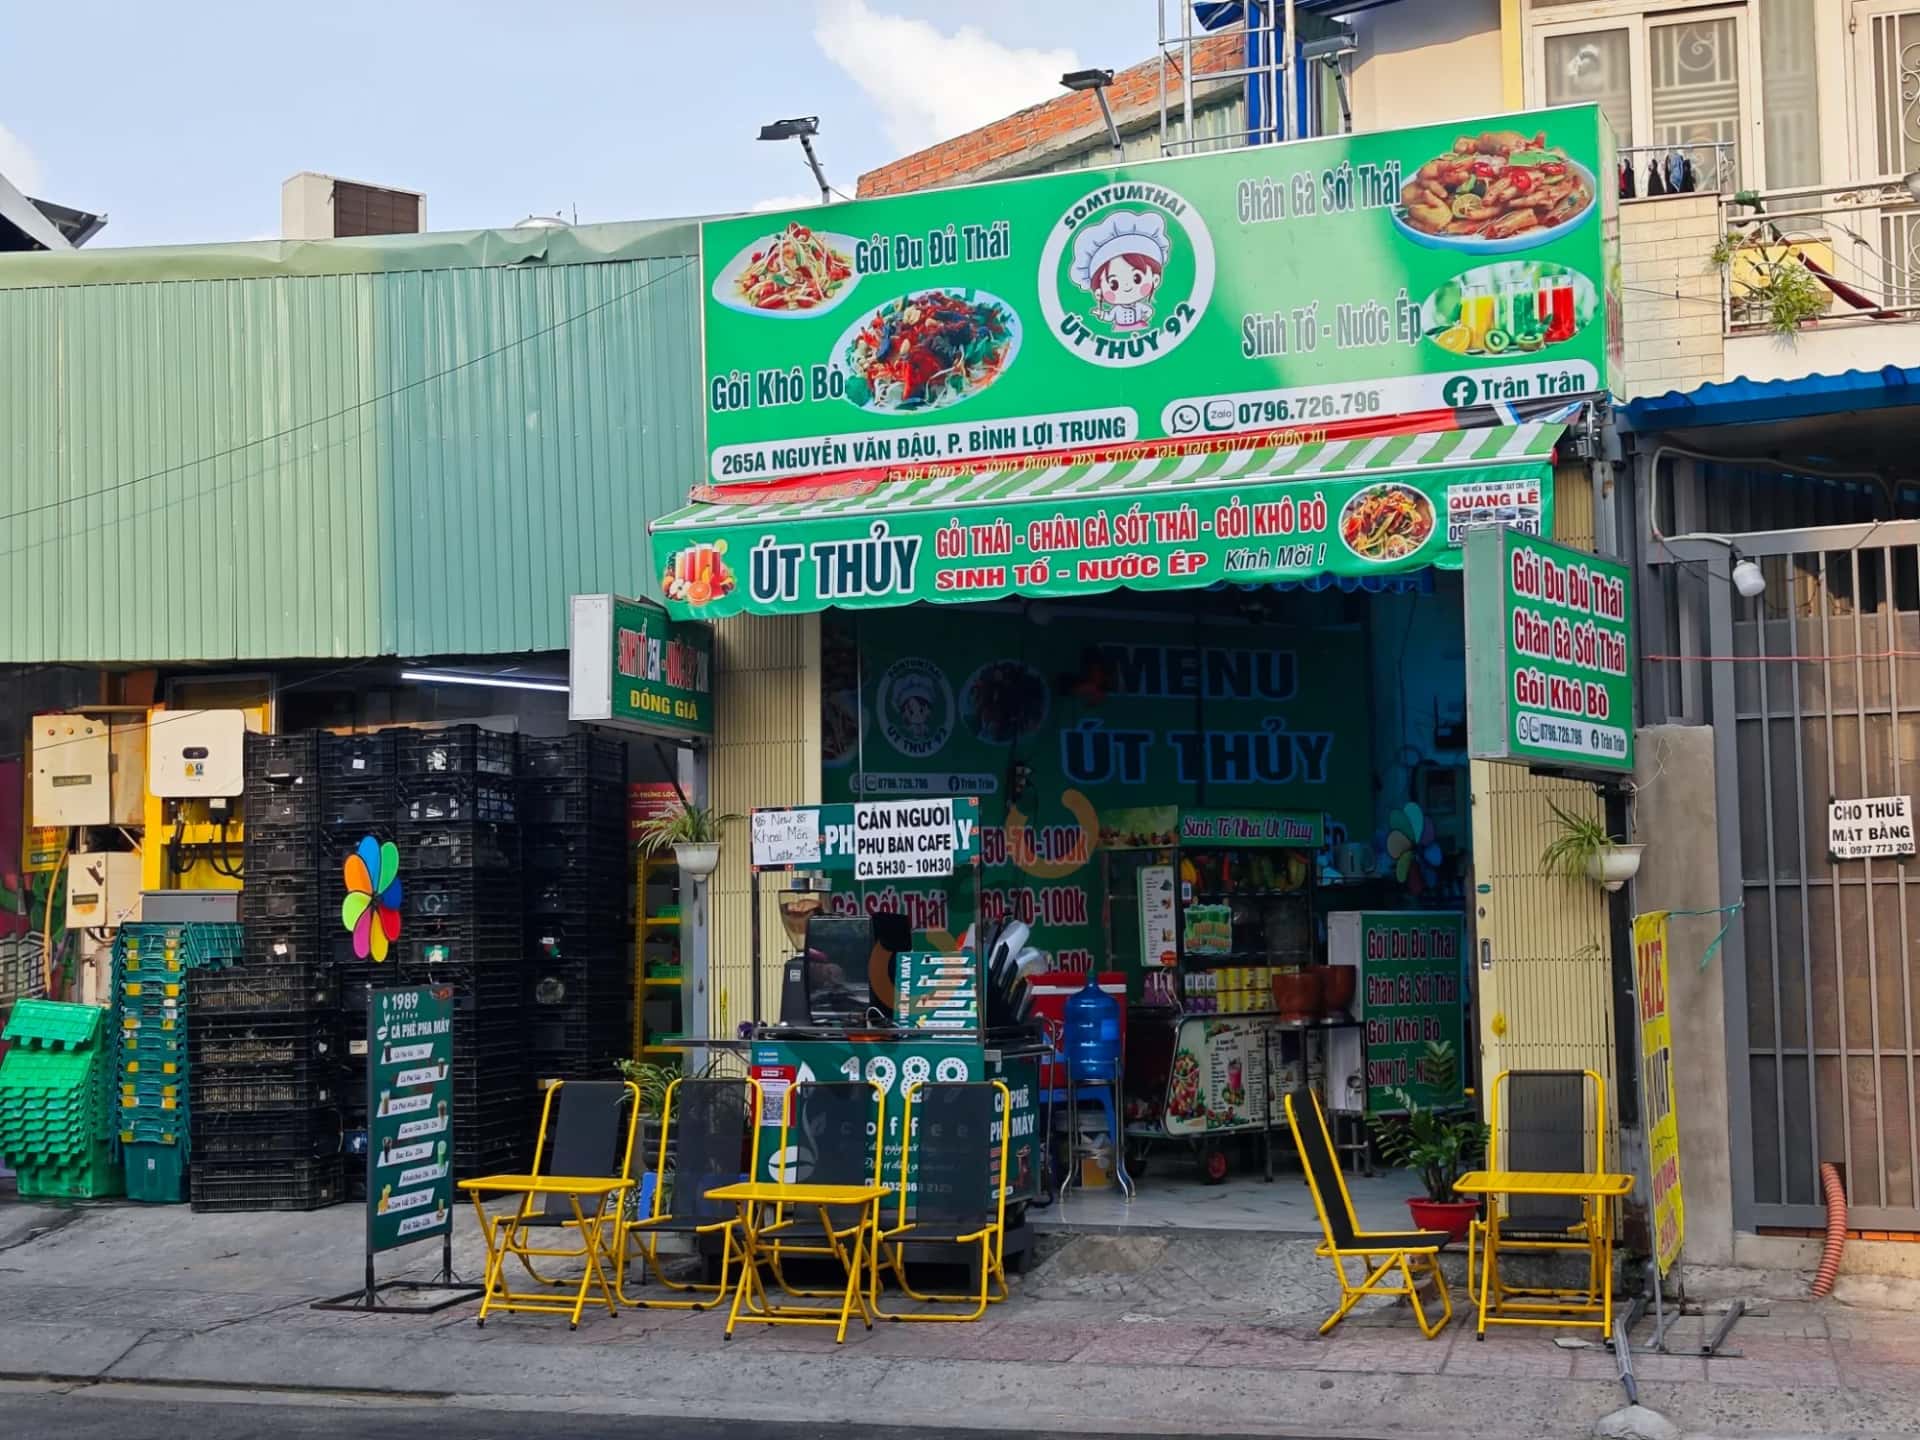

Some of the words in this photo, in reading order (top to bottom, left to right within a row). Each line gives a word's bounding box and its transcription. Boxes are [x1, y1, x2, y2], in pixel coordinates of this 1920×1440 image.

[1064, 185, 1187, 230] SOMTUMTHAI
[1237, 180, 1286, 224] Chân
[1290, 176, 1315, 217] Gà
[1322, 161, 1354, 214] Sốt
[1359, 160, 1400, 210] Thái
[855, 235, 891, 274] Gỏi
[896, 236, 923, 270] Đu
[930, 223, 957, 266] Đủ
[963, 221, 1010, 260] Thái
[1060, 314, 1091, 346] ÚT
[1095, 331, 1160, 360] THỦY
[1166, 303, 1196, 337] 92
[1242, 314, 1287, 358] Sinh
[1292, 301, 1319, 351] Tố
[1336, 299, 1390, 348] Nước
[1397, 288, 1422, 348] Ép
[712, 366, 750, 411] Gỏi
[758, 368, 805, 408] Khô
[812, 362, 843, 402] Bò
[1239, 391, 1380, 424] 0796.726.796
[1482, 373, 1530, 401] Trân
[1536, 369, 1586, 396] Trân
[722, 450, 766, 476] 265A
[772, 437, 847, 471] NGUYỄN
[853, 435, 891, 462] VĂN
[897, 429, 941, 460] ĐẬU,
[948, 428, 963, 454] P.
[970, 420, 1016, 451] BÌNH
[1023, 421, 1052, 448] LỢI
[1060, 416, 1127, 446] TRUNG
[1450, 492, 1512, 510] QUANG
[1517, 488, 1539, 505] LÊ
[753, 541, 801, 600] ÚT
[815, 522, 920, 596] THỦY
[937, 519, 966, 559] GỎI
[971, 519, 1011, 554] THÁI
[1029, 518, 1081, 551] CHÂN
[1084, 510, 1109, 547] GÀ
[1115, 506, 1150, 546] SỐT
[1154, 504, 1197, 542] THÁI
[1217, 496, 1249, 539] GỎI
[1254, 495, 1293, 535] KHÔ
[1300, 492, 1327, 532] BÒ
[936, 568, 1004, 592] SINH
[1014, 557, 1050, 586] TỐ
[1080, 549, 1162, 581] NƯỚC
[1169, 545, 1208, 577] ÉP
[1225, 548, 1269, 572] Kính
[1277, 544, 1315, 569] Mời
[1513, 549, 1539, 595] Gỏi
[1544, 559, 1564, 602] Đu
[1569, 565, 1589, 610] Đủ
[1592, 574, 1624, 619] Thái
[1514, 610, 1551, 656] Chân
[1554, 619, 1571, 661] Gà
[1575, 620, 1596, 667] Sốt
[1599, 630, 1626, 674] Thái
[1090, 643, 1297, 700] MENU
[1516, 669, 1546, 706] Gỏi
[1551, 677, 1582, 713] Khô
[1587, 683, 1609, 718] Bò
[1060, 717, 1156, 785] ÚT
[1166, 715, 1335, 785] THỦY
[1834, 804, 1862, 821] CHO
[1865, 797, 1905, 819] THUÊ
[1869, 820, 1911, 841] BẰNG
[825, 824, 856, 856] PH
[918, 833, 951, 852] CAFE
[982, 825, 1089, 865] 50-70-100k
[1850, 845, 1873, 856] 0937
[1876, 843, 1894, 854] 773
[858, 861, 873, 876] CA
[877, 859, 906, 876] 5H30
[916, 857, 952, 874] 10H30
[902, 891, 948, 930] Thái
[391, 991, 419, 1010] 1989
